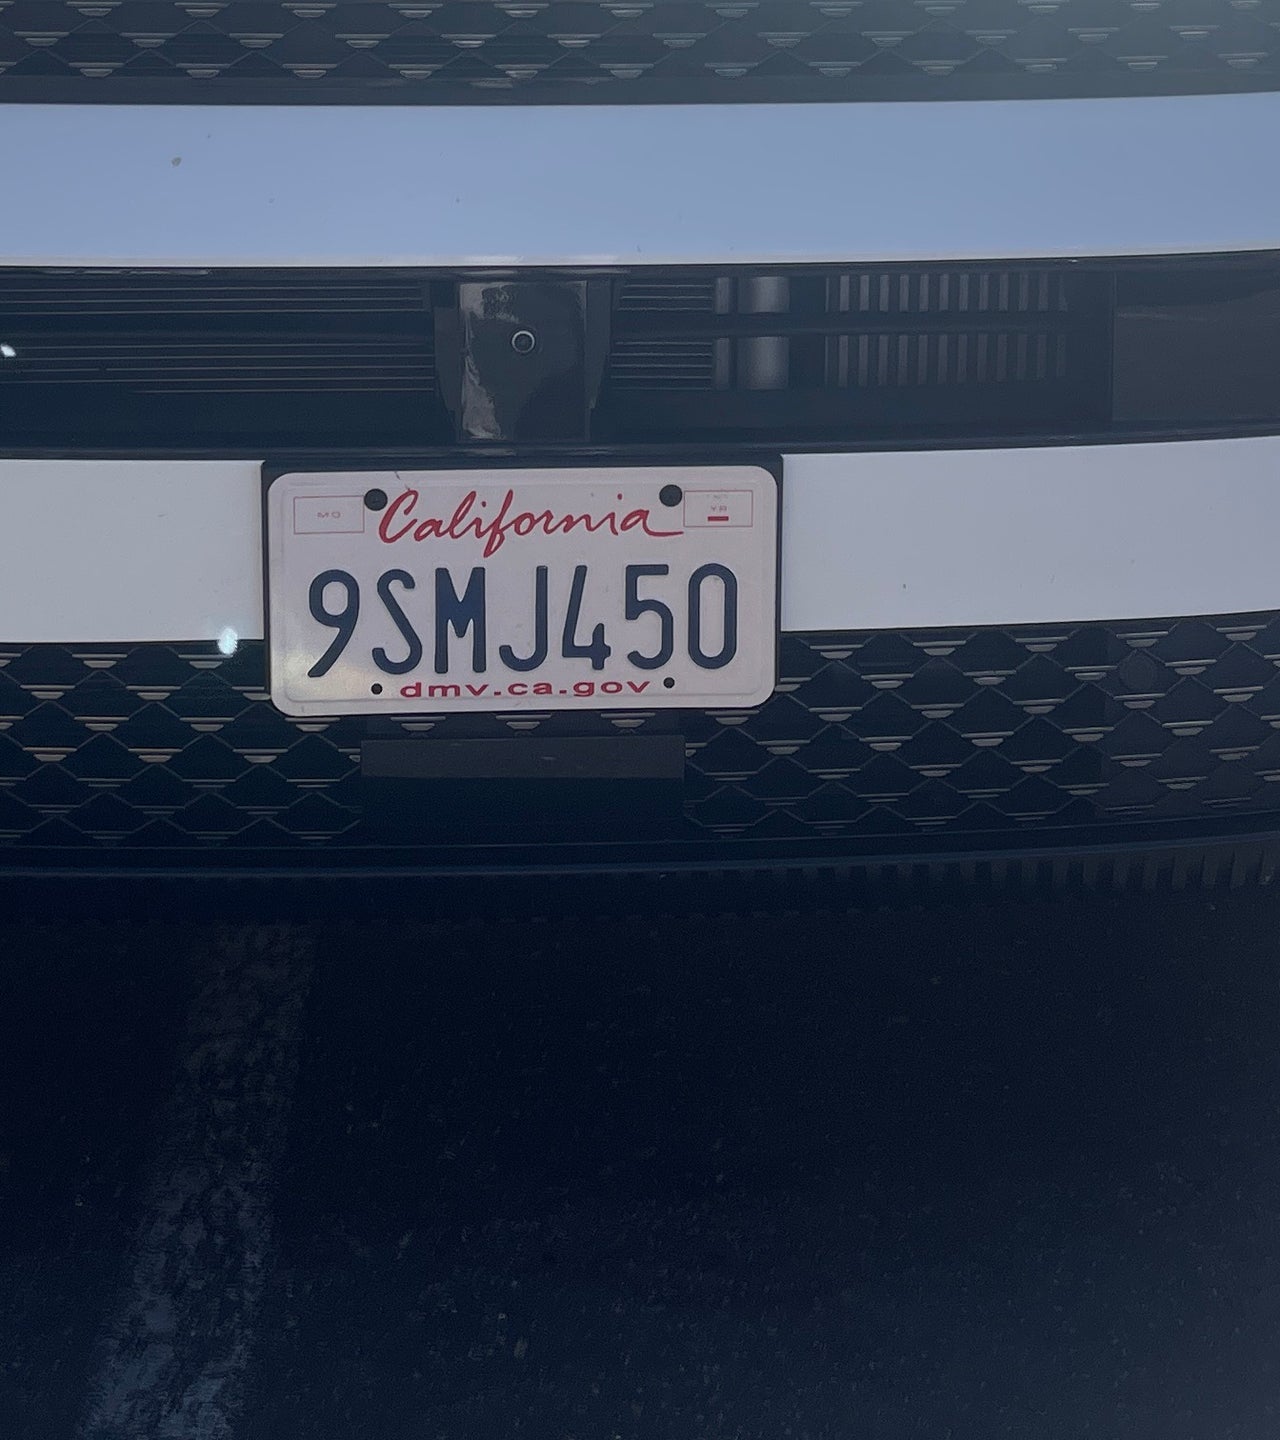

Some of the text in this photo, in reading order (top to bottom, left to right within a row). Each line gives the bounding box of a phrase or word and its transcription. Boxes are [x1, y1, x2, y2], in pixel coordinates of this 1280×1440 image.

[317, 511, 341, 519] MO
[379, 489, 684, 558] California
[307, 563, 738, 678] 9SMJ450
[399, 679, 651, 698] dmv.ca.gov
